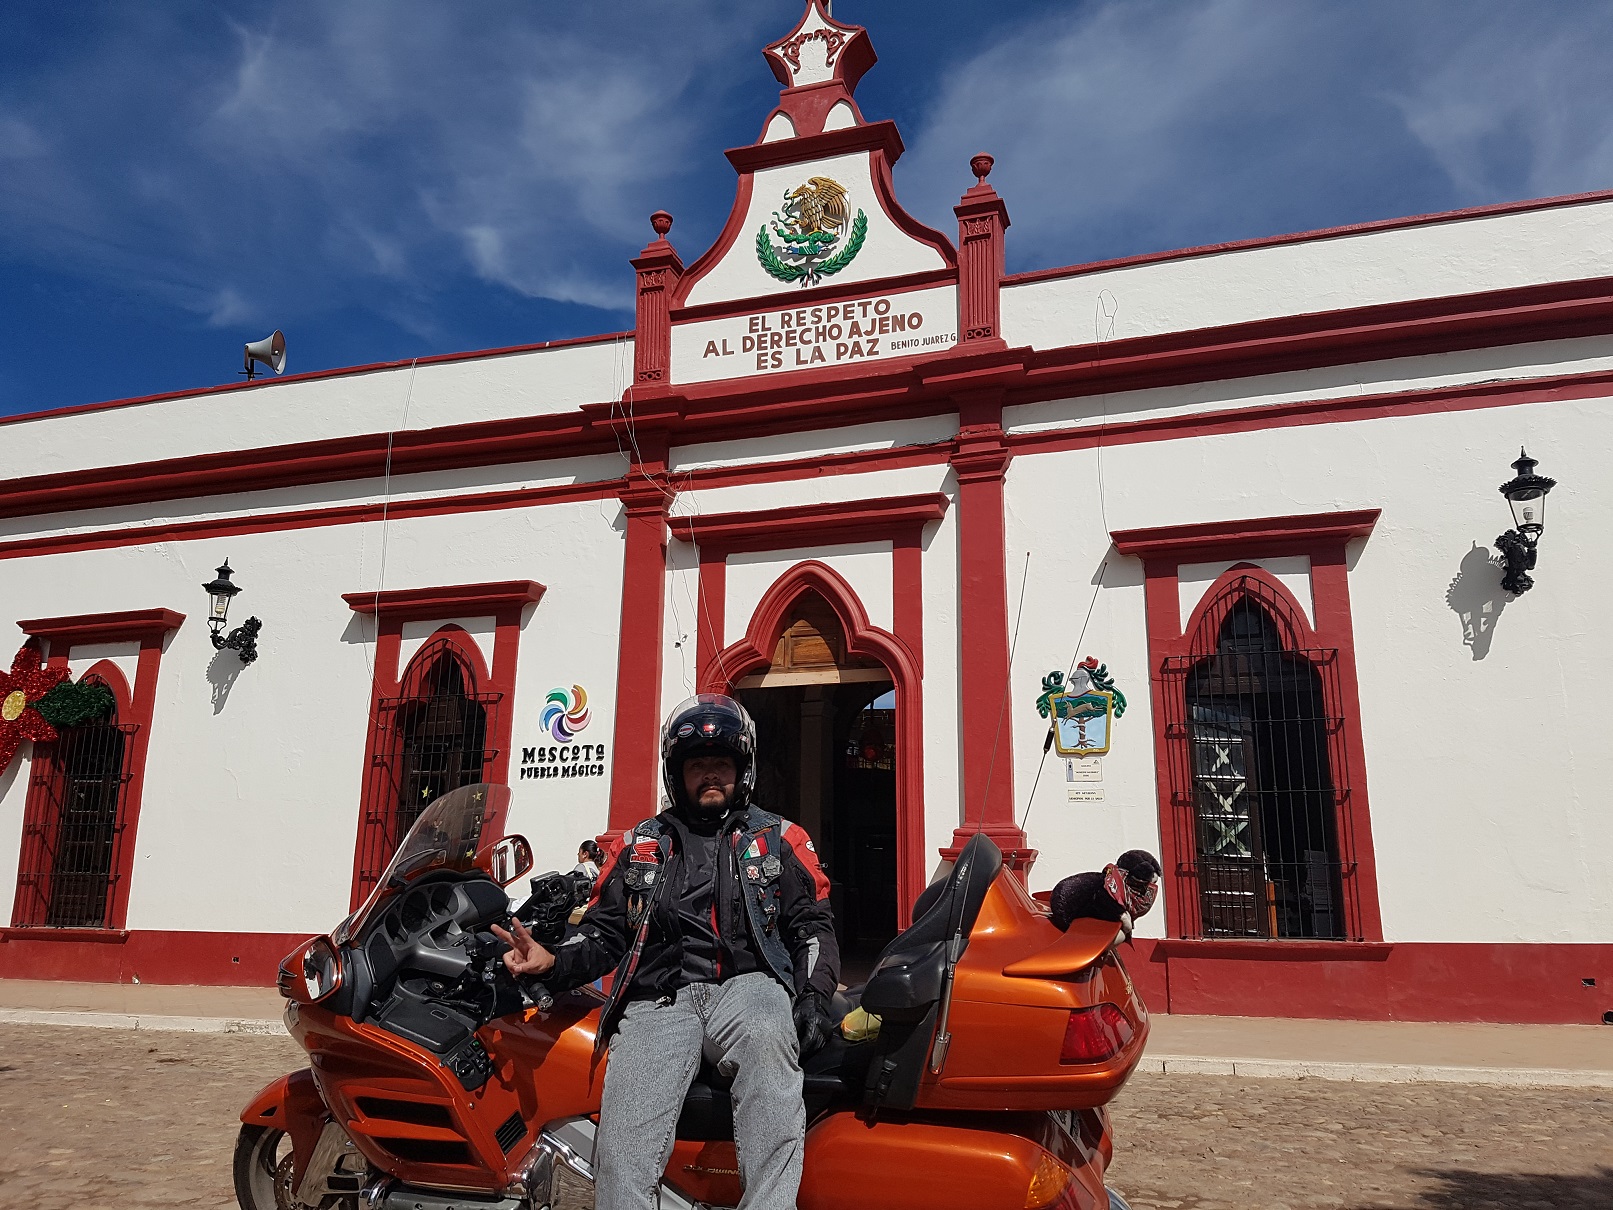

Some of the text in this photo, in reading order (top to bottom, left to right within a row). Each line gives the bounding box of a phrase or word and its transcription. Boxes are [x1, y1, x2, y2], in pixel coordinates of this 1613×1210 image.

[749, 298, 891, 334] EL RESPETO
[702, 312, 924, 358] AL DERECHO AJENO
[890, 338, 920, 351] BENITO
[921, 334, 949, 346] JUAREZ
[756, 338, 880, 371] ES LA PAZ
